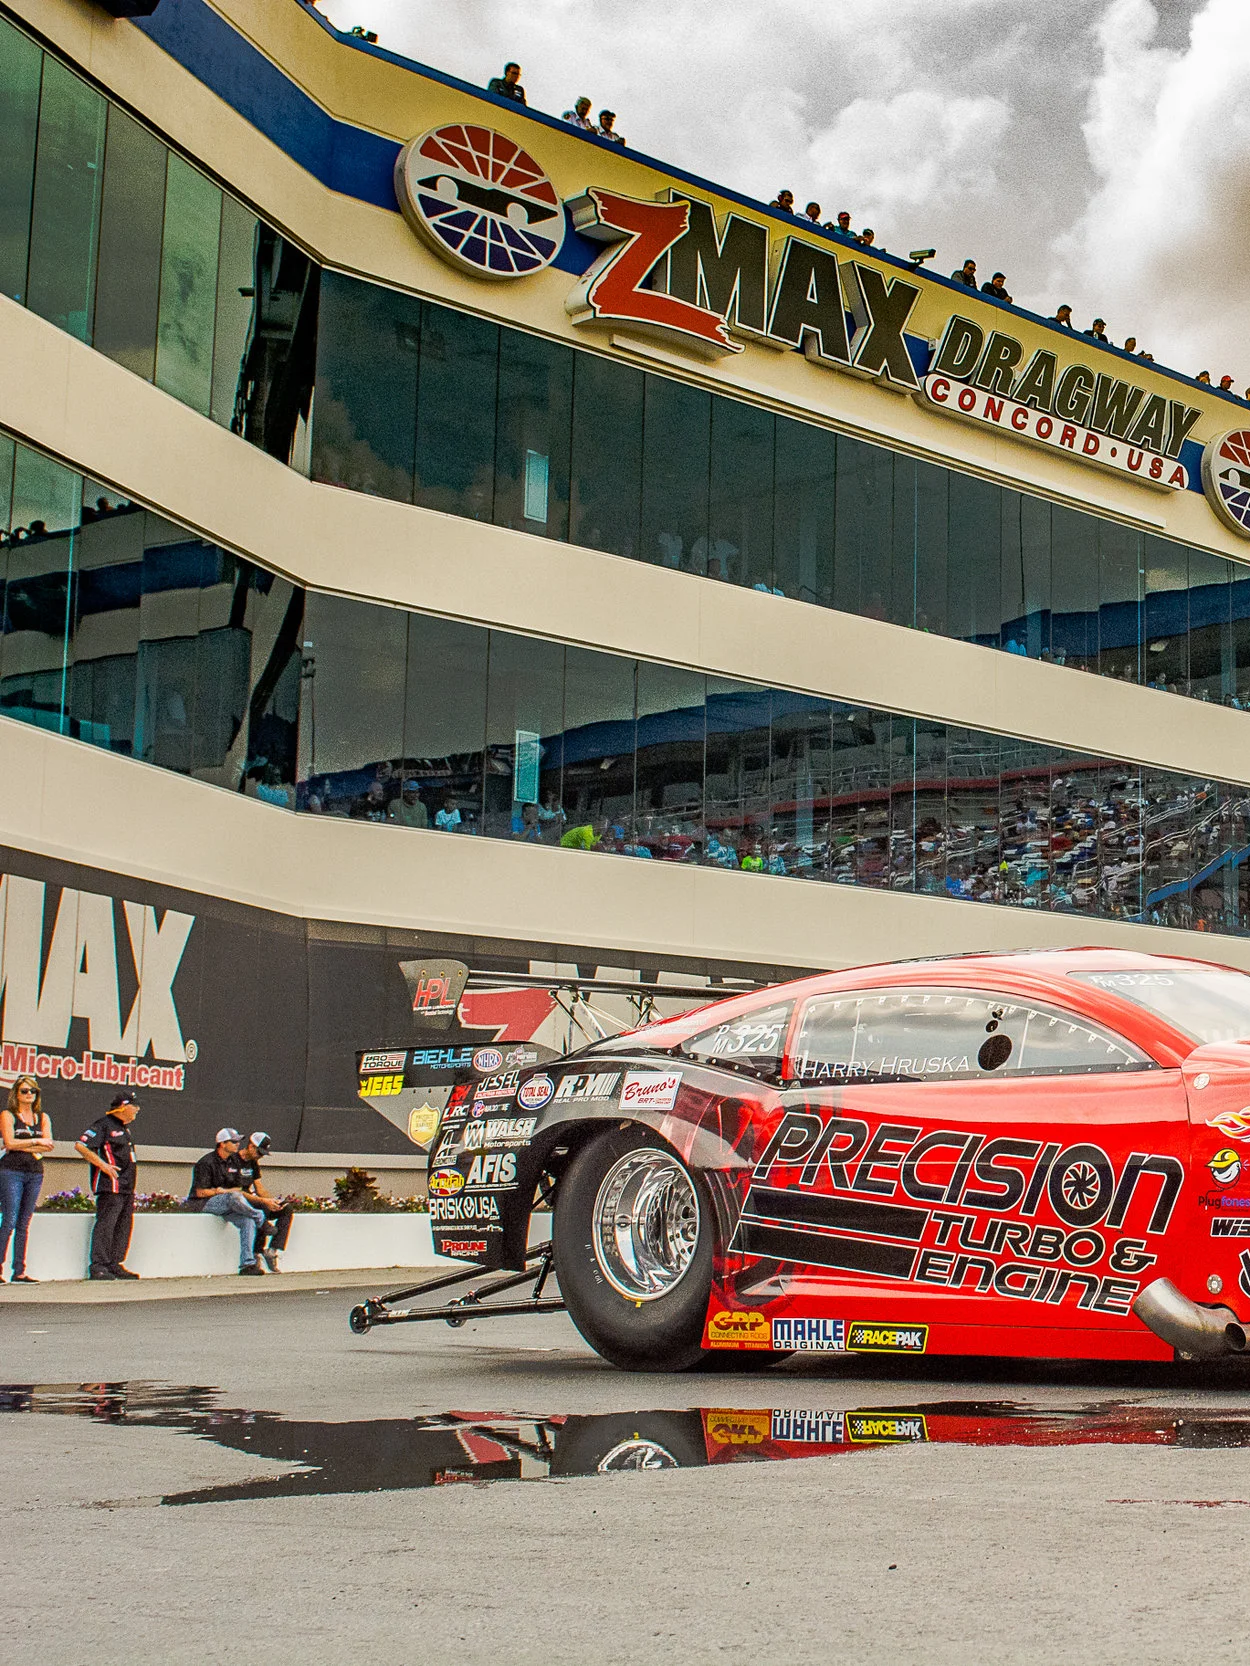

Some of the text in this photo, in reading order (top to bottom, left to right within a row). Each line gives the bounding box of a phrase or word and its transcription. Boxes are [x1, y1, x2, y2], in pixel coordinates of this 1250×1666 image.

[933, 313, 1202, 460] DRAGWAY
[928, 373, 1188, 489] CONCORD USA
[1118, 973, 1175, 987] 325
[413, 978, 456, 1006] HPL
[728, 1024, 787, 1053] 325
[413, 1047, 474, 1065] BIEHLE
[477, 1052, 500, 1068] NHRA
[802, 1056, 970, 1078] HARRY HRUSKA
[1, 1045, 184, 1091] Micro-lubricant
[360, 1075, 404, 1098] JEGS
[478, 1070, 519, 1092] JESEL
[624, 1077, 677, 1101] Bruno's
[485, 1118, 537, 1139] WALSH
[483, 1139, 532, 1149] Motorsports
[465, 1152, 517, 1185] AFIS
[753, 1112, 1184, 1235] PRECISION
[1198, 1195, 1250, 1211] Plugfones
[927, 1210, 1158, 1274] TURBO &
[914, 1249, 1141, 1317] ENGINE
[713, 1311, 765, 1332] GRP
[773, 1319, 844, 1341] MAHLE
[711, 1331, 768, 1340] CONNECTING RODS
[773, 1340, 843, 1350] ORIGINAL
[863, 1329, 922, 1346] RACEPAK
